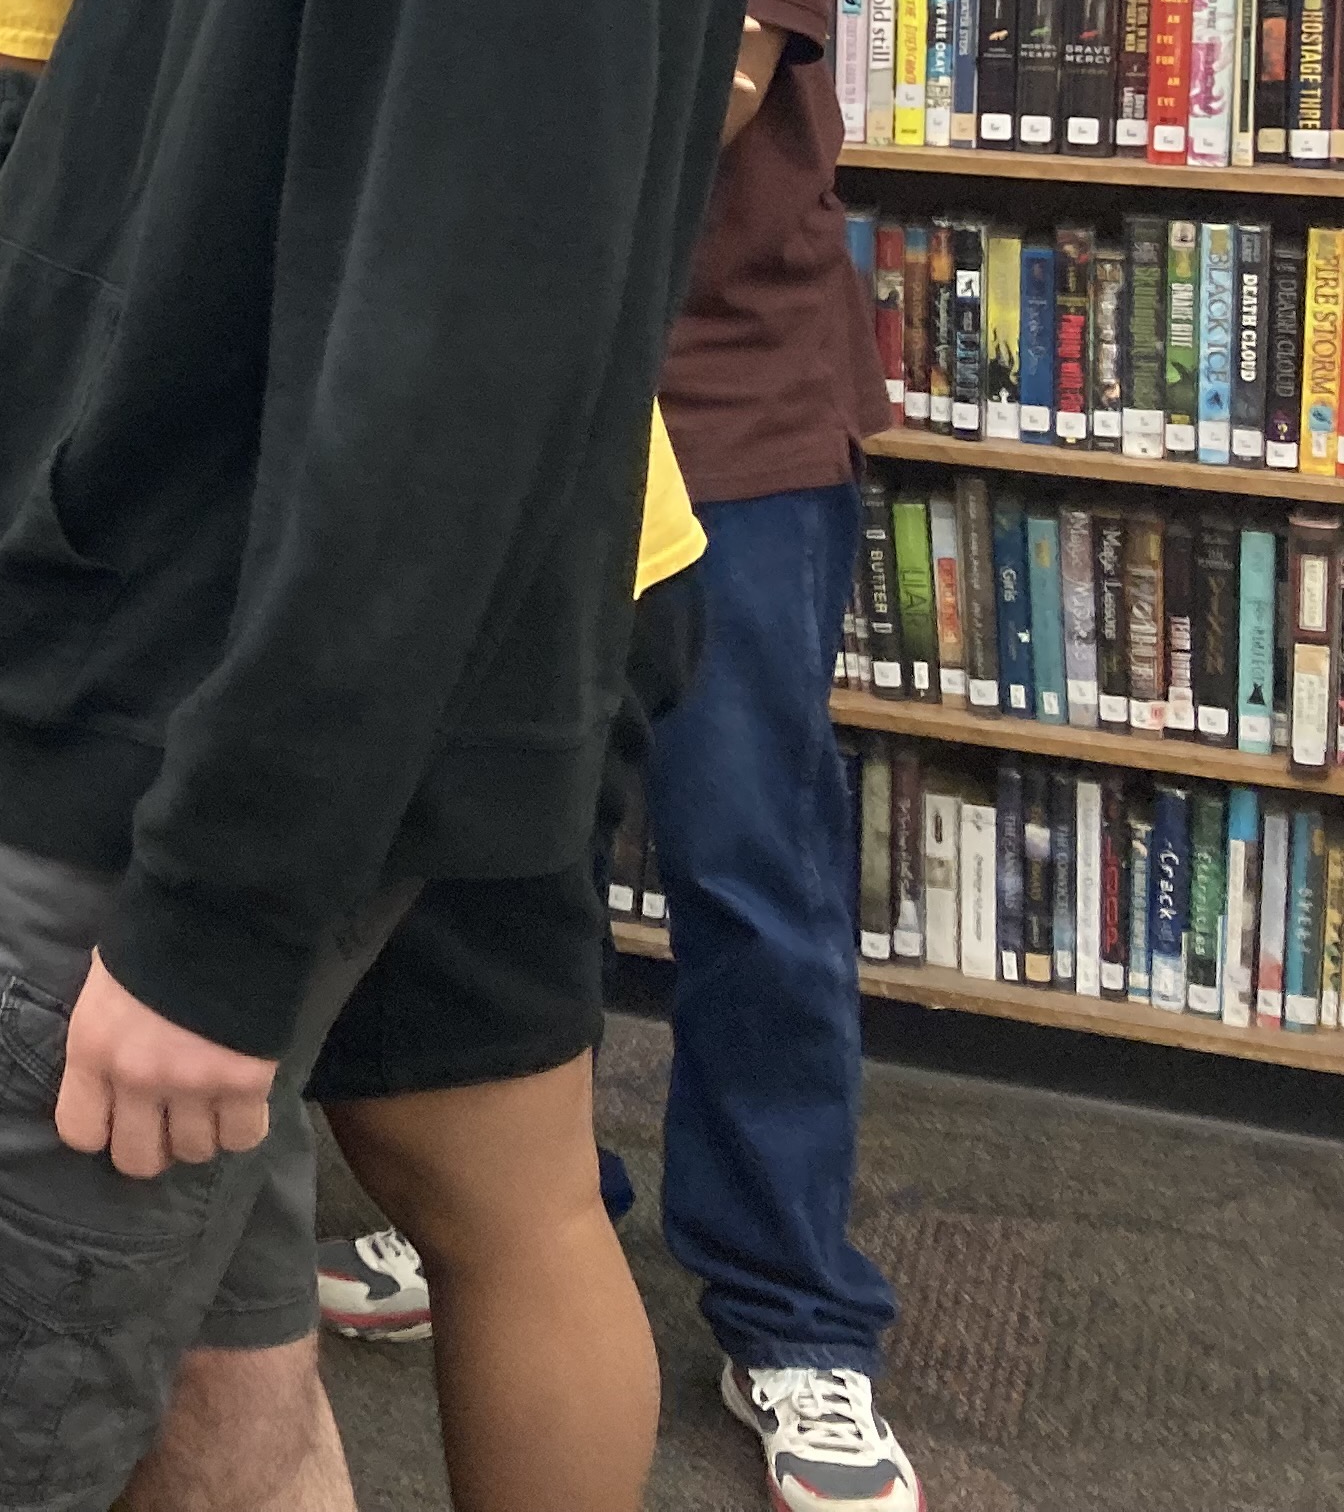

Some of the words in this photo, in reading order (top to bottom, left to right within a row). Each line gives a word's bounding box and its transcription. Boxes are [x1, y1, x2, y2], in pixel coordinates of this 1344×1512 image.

[874, 26, 891, 62] still
[936, 18, 947, 38] ARE
[1298, 10, 1324, 83] HOSTAGE
[936, 42, 946, 74] OKAY
[1065, 45, 1111, 54] GRAVE
[1065, 54, 1112, 64] MERCY
[1298, 88, 1322, 130] THRE
[1240, 273, 1258, 327] DEATH
[1207, 342, 1228, 384] ICE
[1240, 330, 1257, 382] CLOUD
[1310, 312, 1338, 397] STORM
[870, 550, 888, 614] BUTTER
